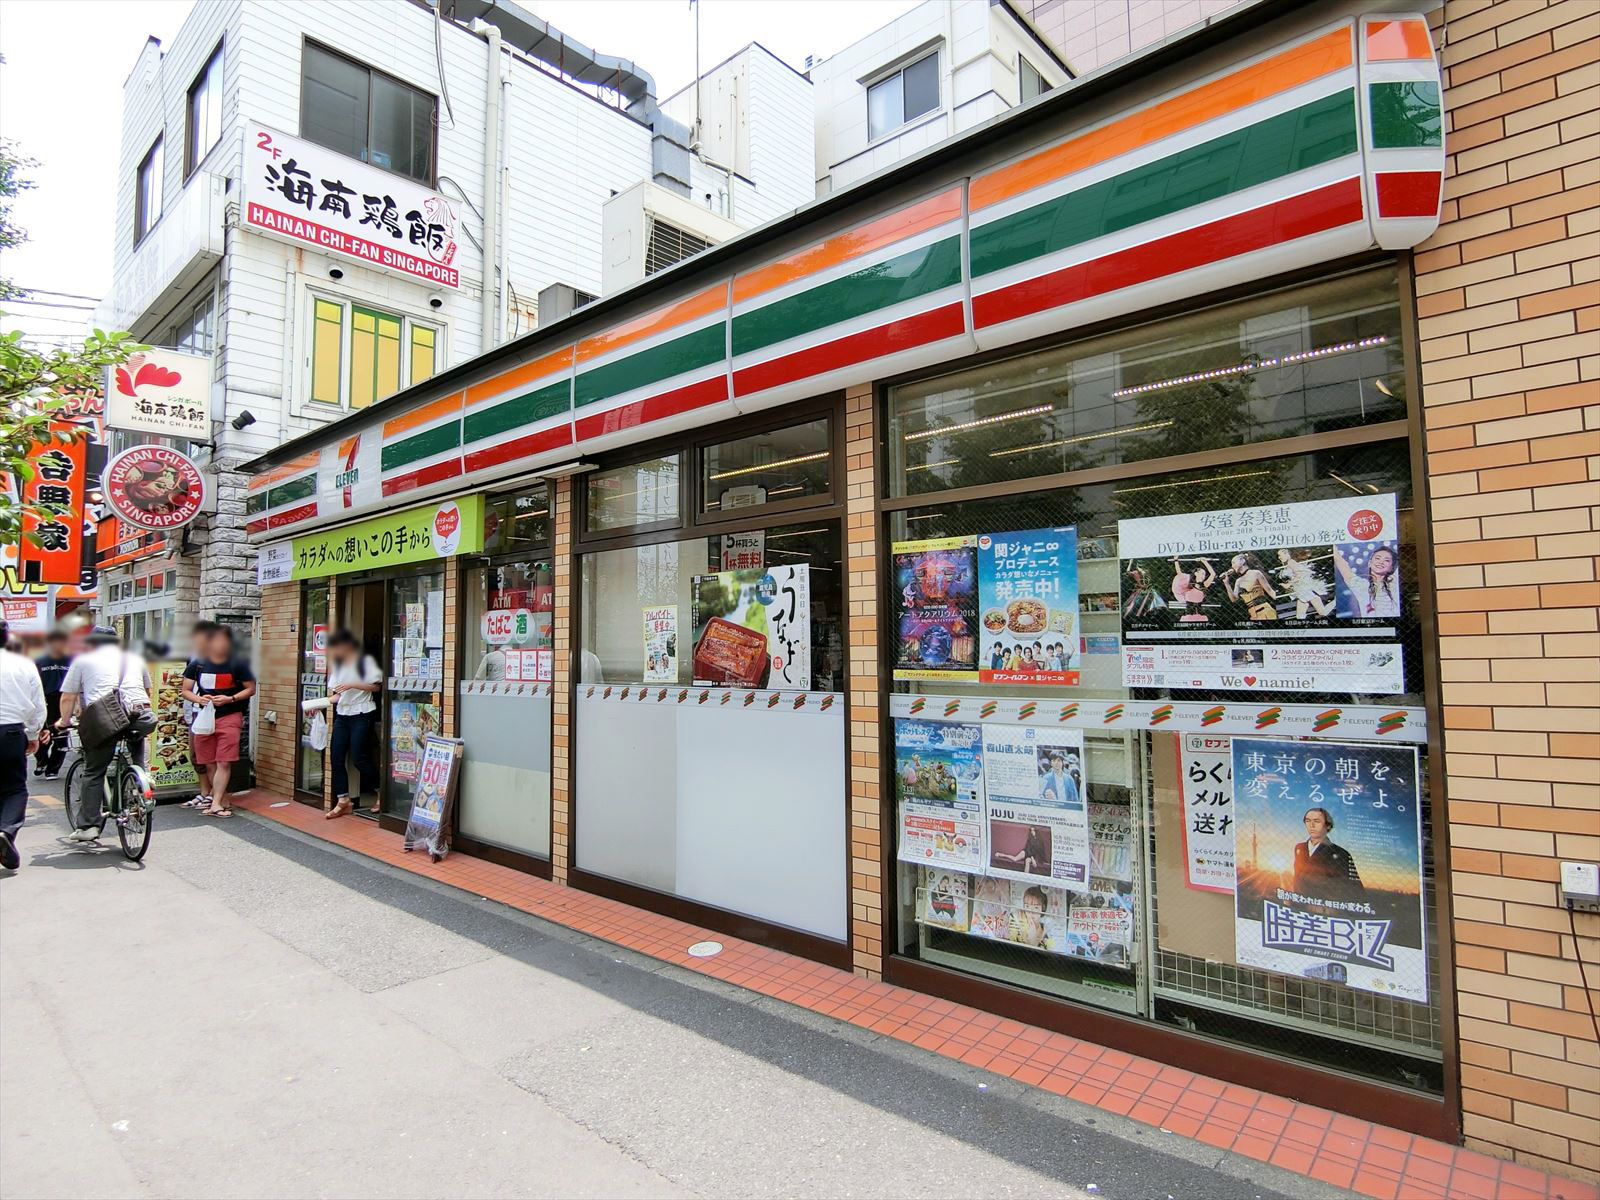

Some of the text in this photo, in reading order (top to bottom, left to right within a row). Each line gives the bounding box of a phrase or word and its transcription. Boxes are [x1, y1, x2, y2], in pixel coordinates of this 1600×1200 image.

[257, 132, 282, 160] 2F
[264, 158, 446, 251] 海南鶏飯
[252, 207, 316, 240] HAINAN
[320, 229, 380, 261] CHI-FAN
[384, 250, 458, 286] SINGAPORE
[135, 398, 204, 422] 海南鶏飯
[132, 416, 204, 430] HAINAN CHI-FAN
[112, 450, 200, 487] HAINAN CHI-FAN
[338, 432, 361, 508] 7
[119, 499, 198, 527] SINGAPORE
[1200, 507, 1291, 530] 安室 奈美恵
[1352, 514, 1378, 528] ご注文
[1353, 523, 1380, 536] 承り中
[299, 525, 431, 570] カラダへの想いこの手から
[1158, 542, 1185, 554] DVD
[1188, 544, 1197, 553] &
[1199, 539, 1245, 552] Blu-ray
[722, 550, 762, 570] 1杯無料
[995, 556, 1059, 570] プロデュース
[493, 595, 511, 609] ATM
[541, 592, 552, 606] AT
[487, 614, 527, 635] たばこ 酒
[772, 566, 799, 684] うなぎ
[898, 610, 958, 619] アートアクアリウム
[1220, 675, 1315, 689] We namie!
[986, 744, 1034, 755] 森山直太朗
[424, 760, 441, 784] 50
[1244, 750, 1405, 784] 東京の朝を、
[1246, 778, 1406, 812] 変えるぜよ。
[990, 808, 1014, 819] JUJU
[1092, 822, 1131, 834] できる人の
[1277, 888, 1376, 914] 朝が変われば、毎日が変わる。
